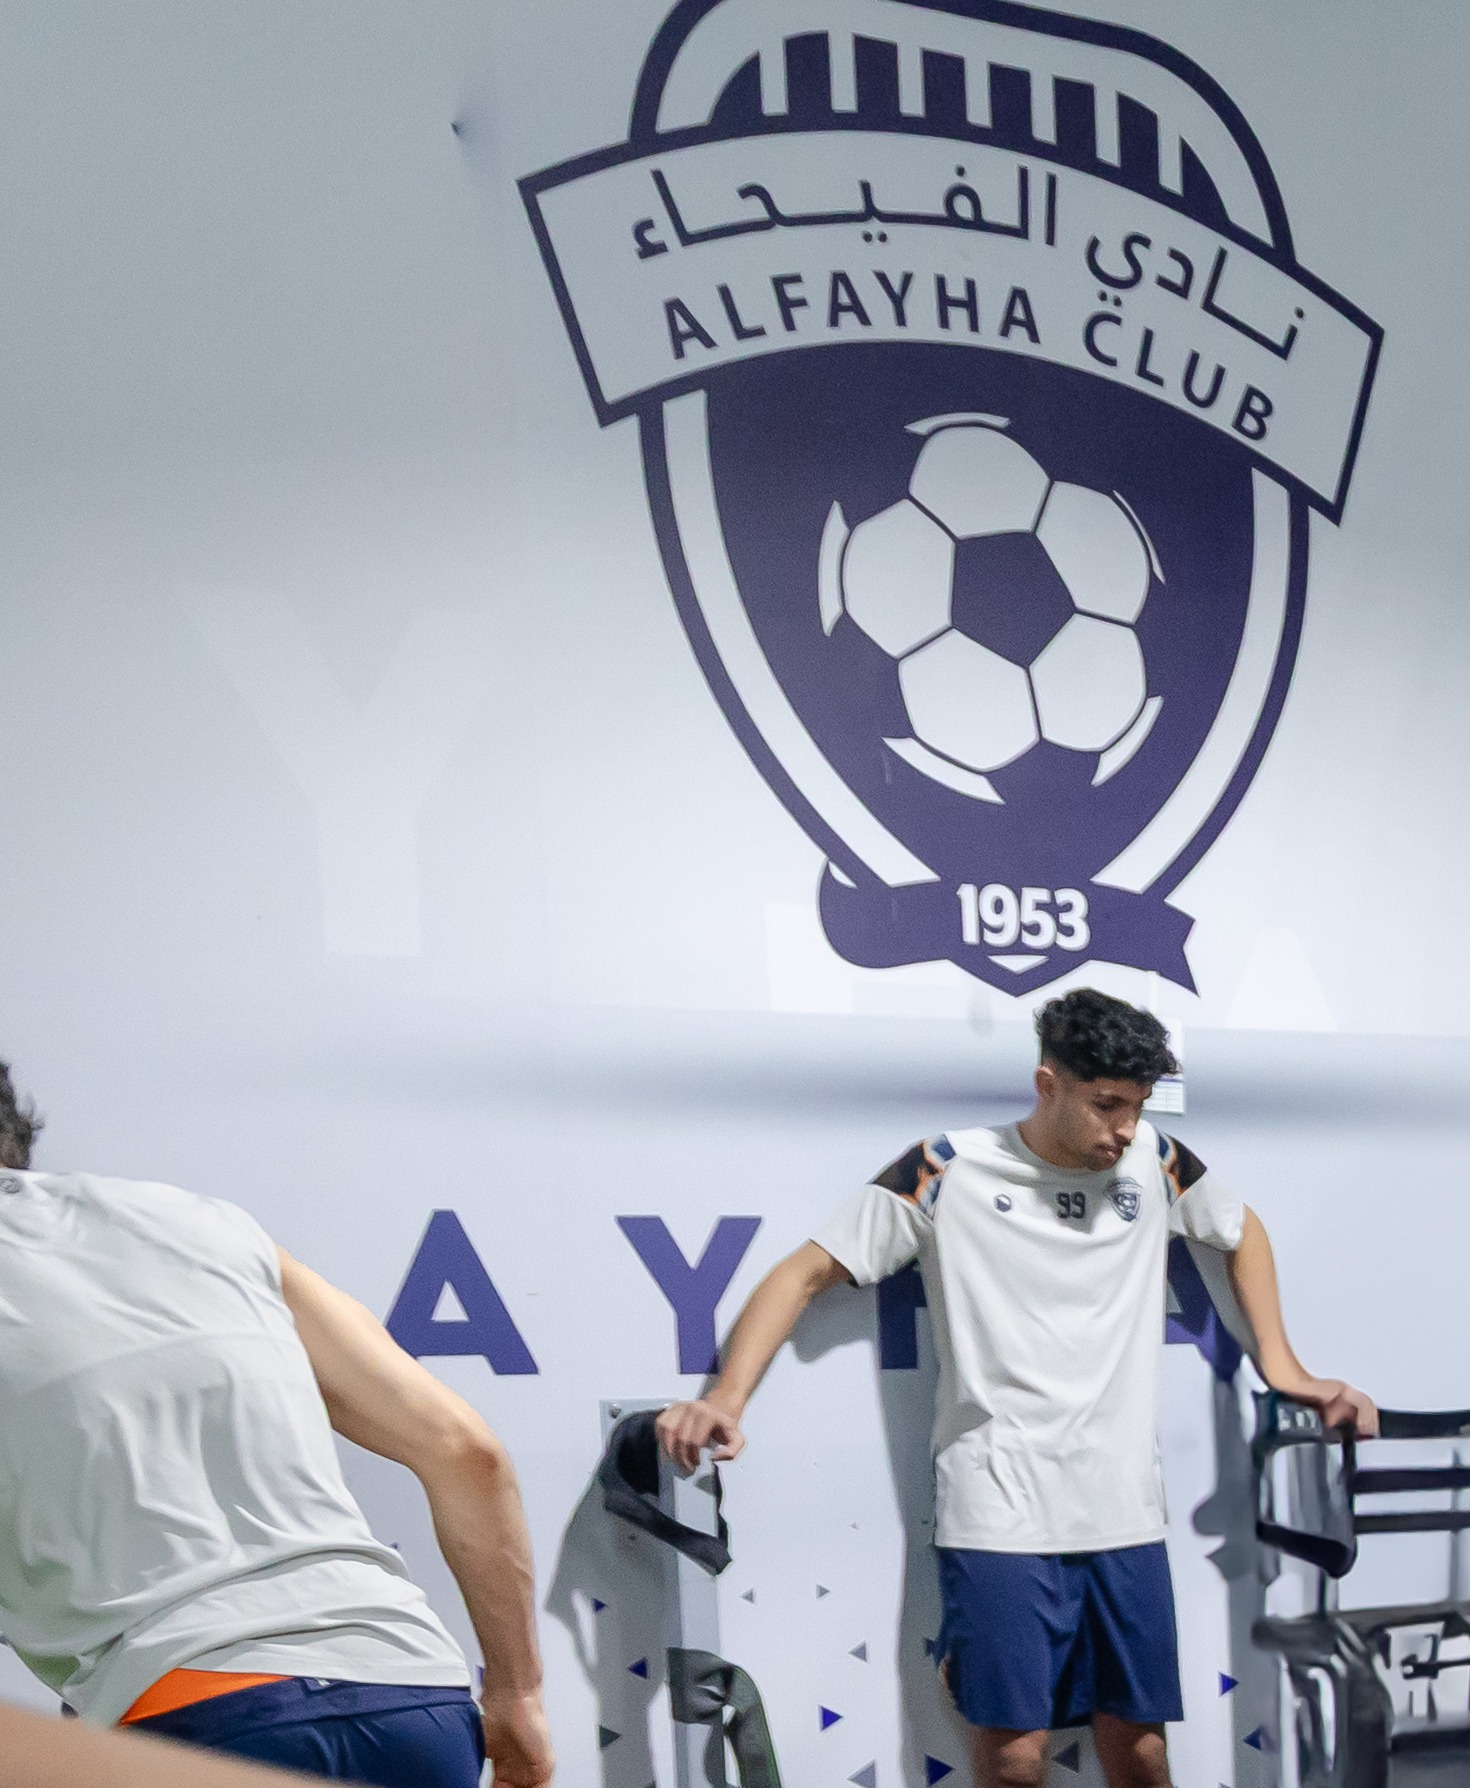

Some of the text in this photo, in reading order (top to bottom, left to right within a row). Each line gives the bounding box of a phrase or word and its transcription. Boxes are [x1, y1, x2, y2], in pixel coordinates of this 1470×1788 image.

[632, 164, 1308, 361] نادي الفيحاء
[663, 269, 1274, 442] ALFAYHA CLUB
[956, 882, 1090, 951] 1953
[1055, 1190, 1086, 1219] 99
